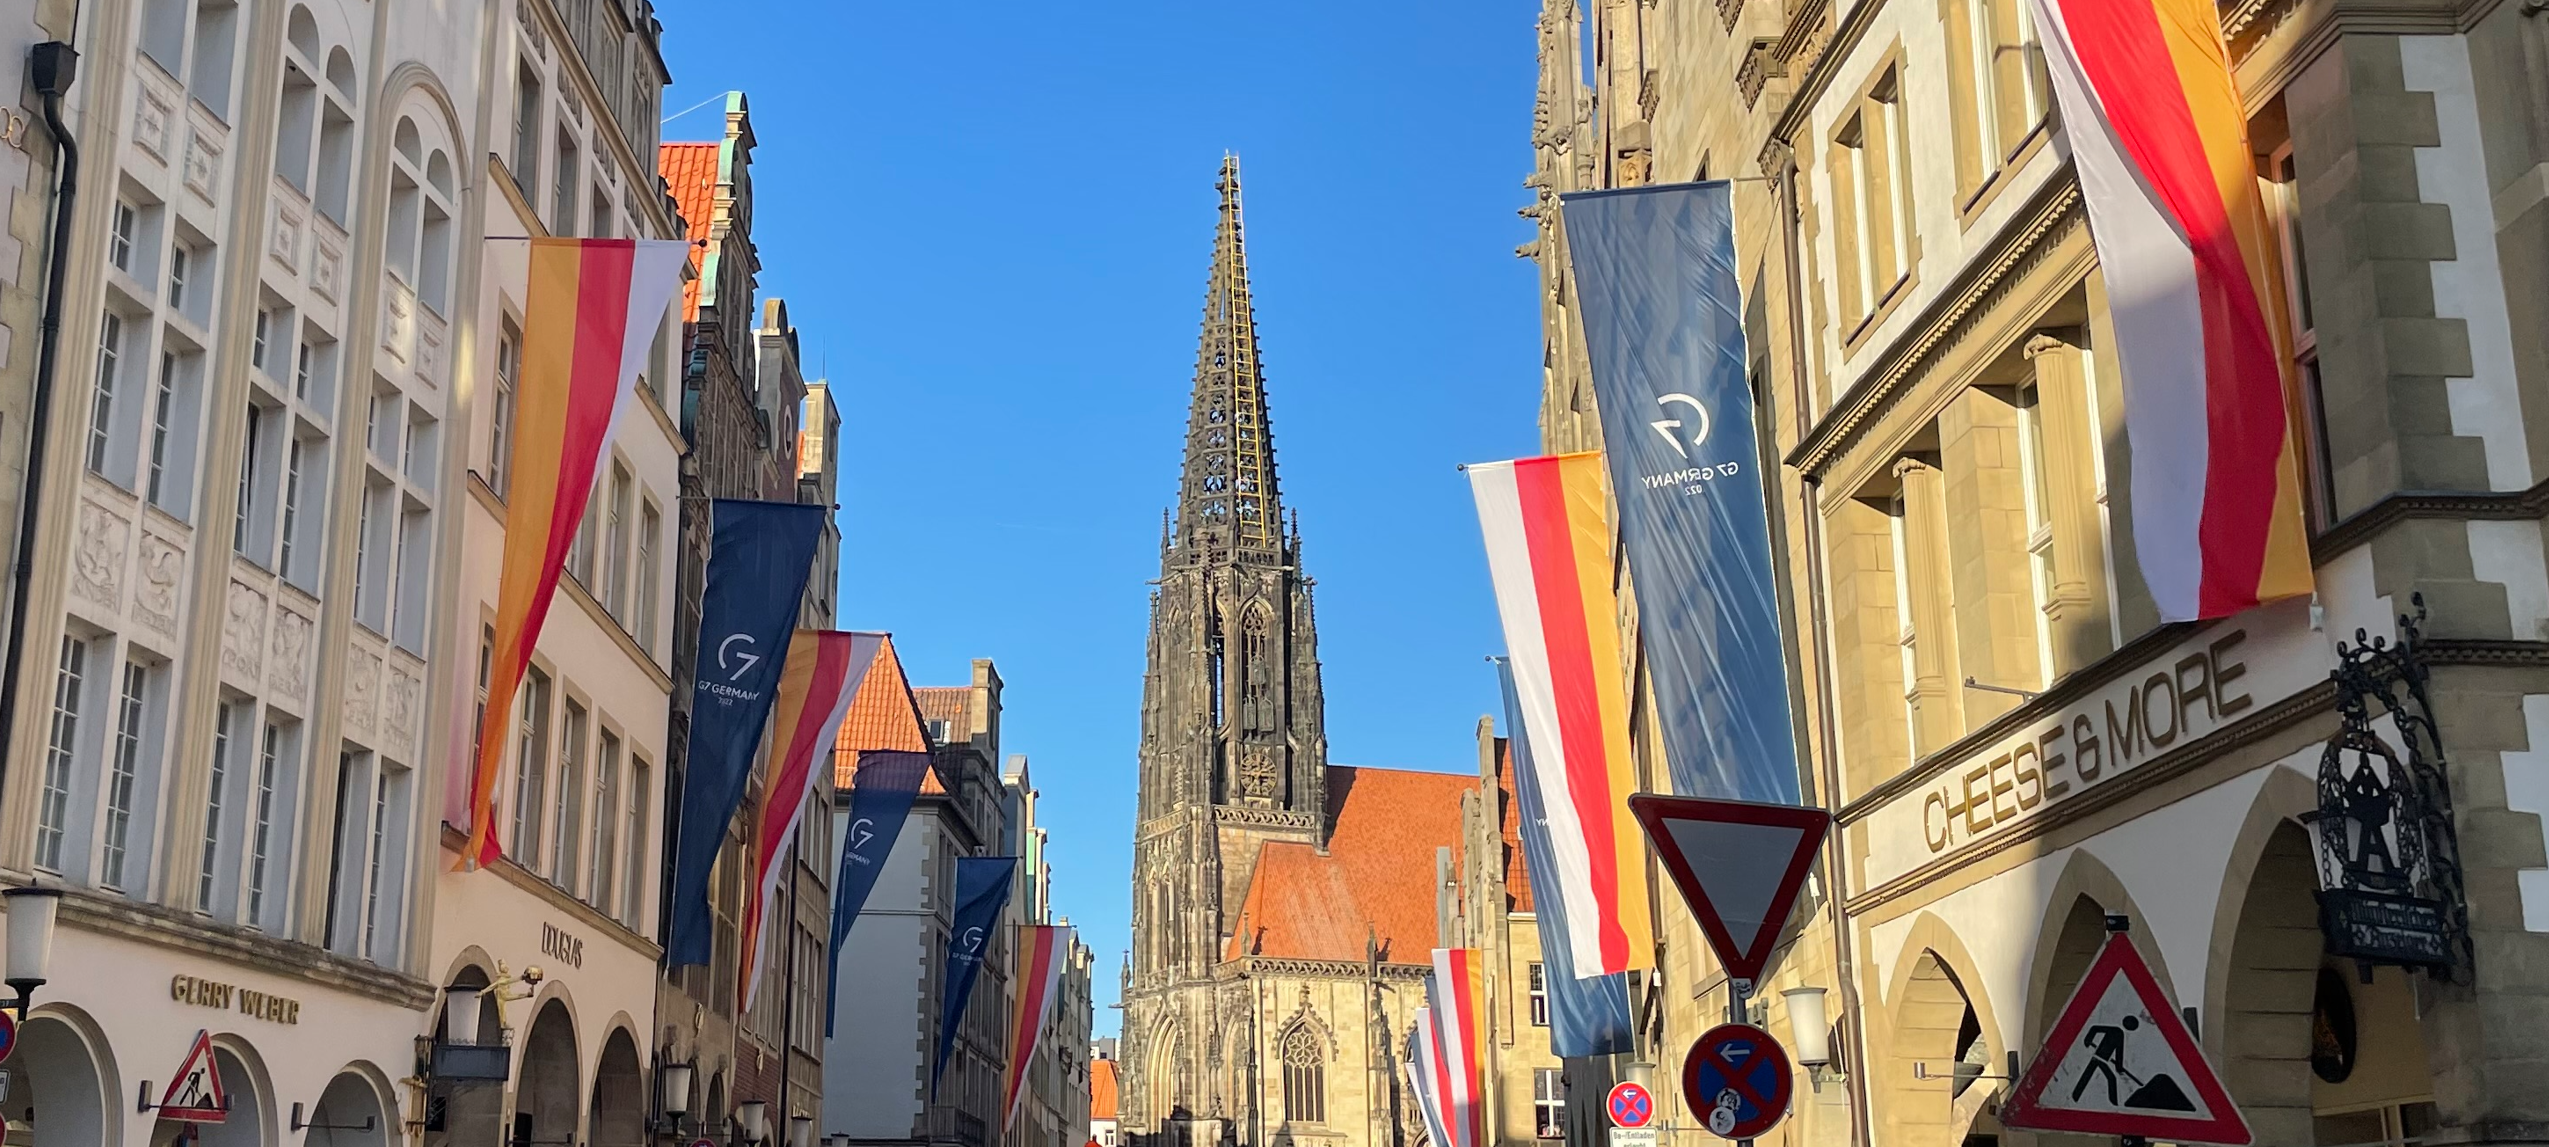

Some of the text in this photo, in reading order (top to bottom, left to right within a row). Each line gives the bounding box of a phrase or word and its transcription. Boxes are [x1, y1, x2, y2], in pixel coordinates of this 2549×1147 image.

[718, 633, 760, 681] G7
[698, 680, 760, 701] G7 GERMANY
[1924, 628, 2253, 854] CHEESE & MORE
[541, 921, 583, 970] DOUGLAS
[171, 973, 299, 1025] GERRY WEBER
